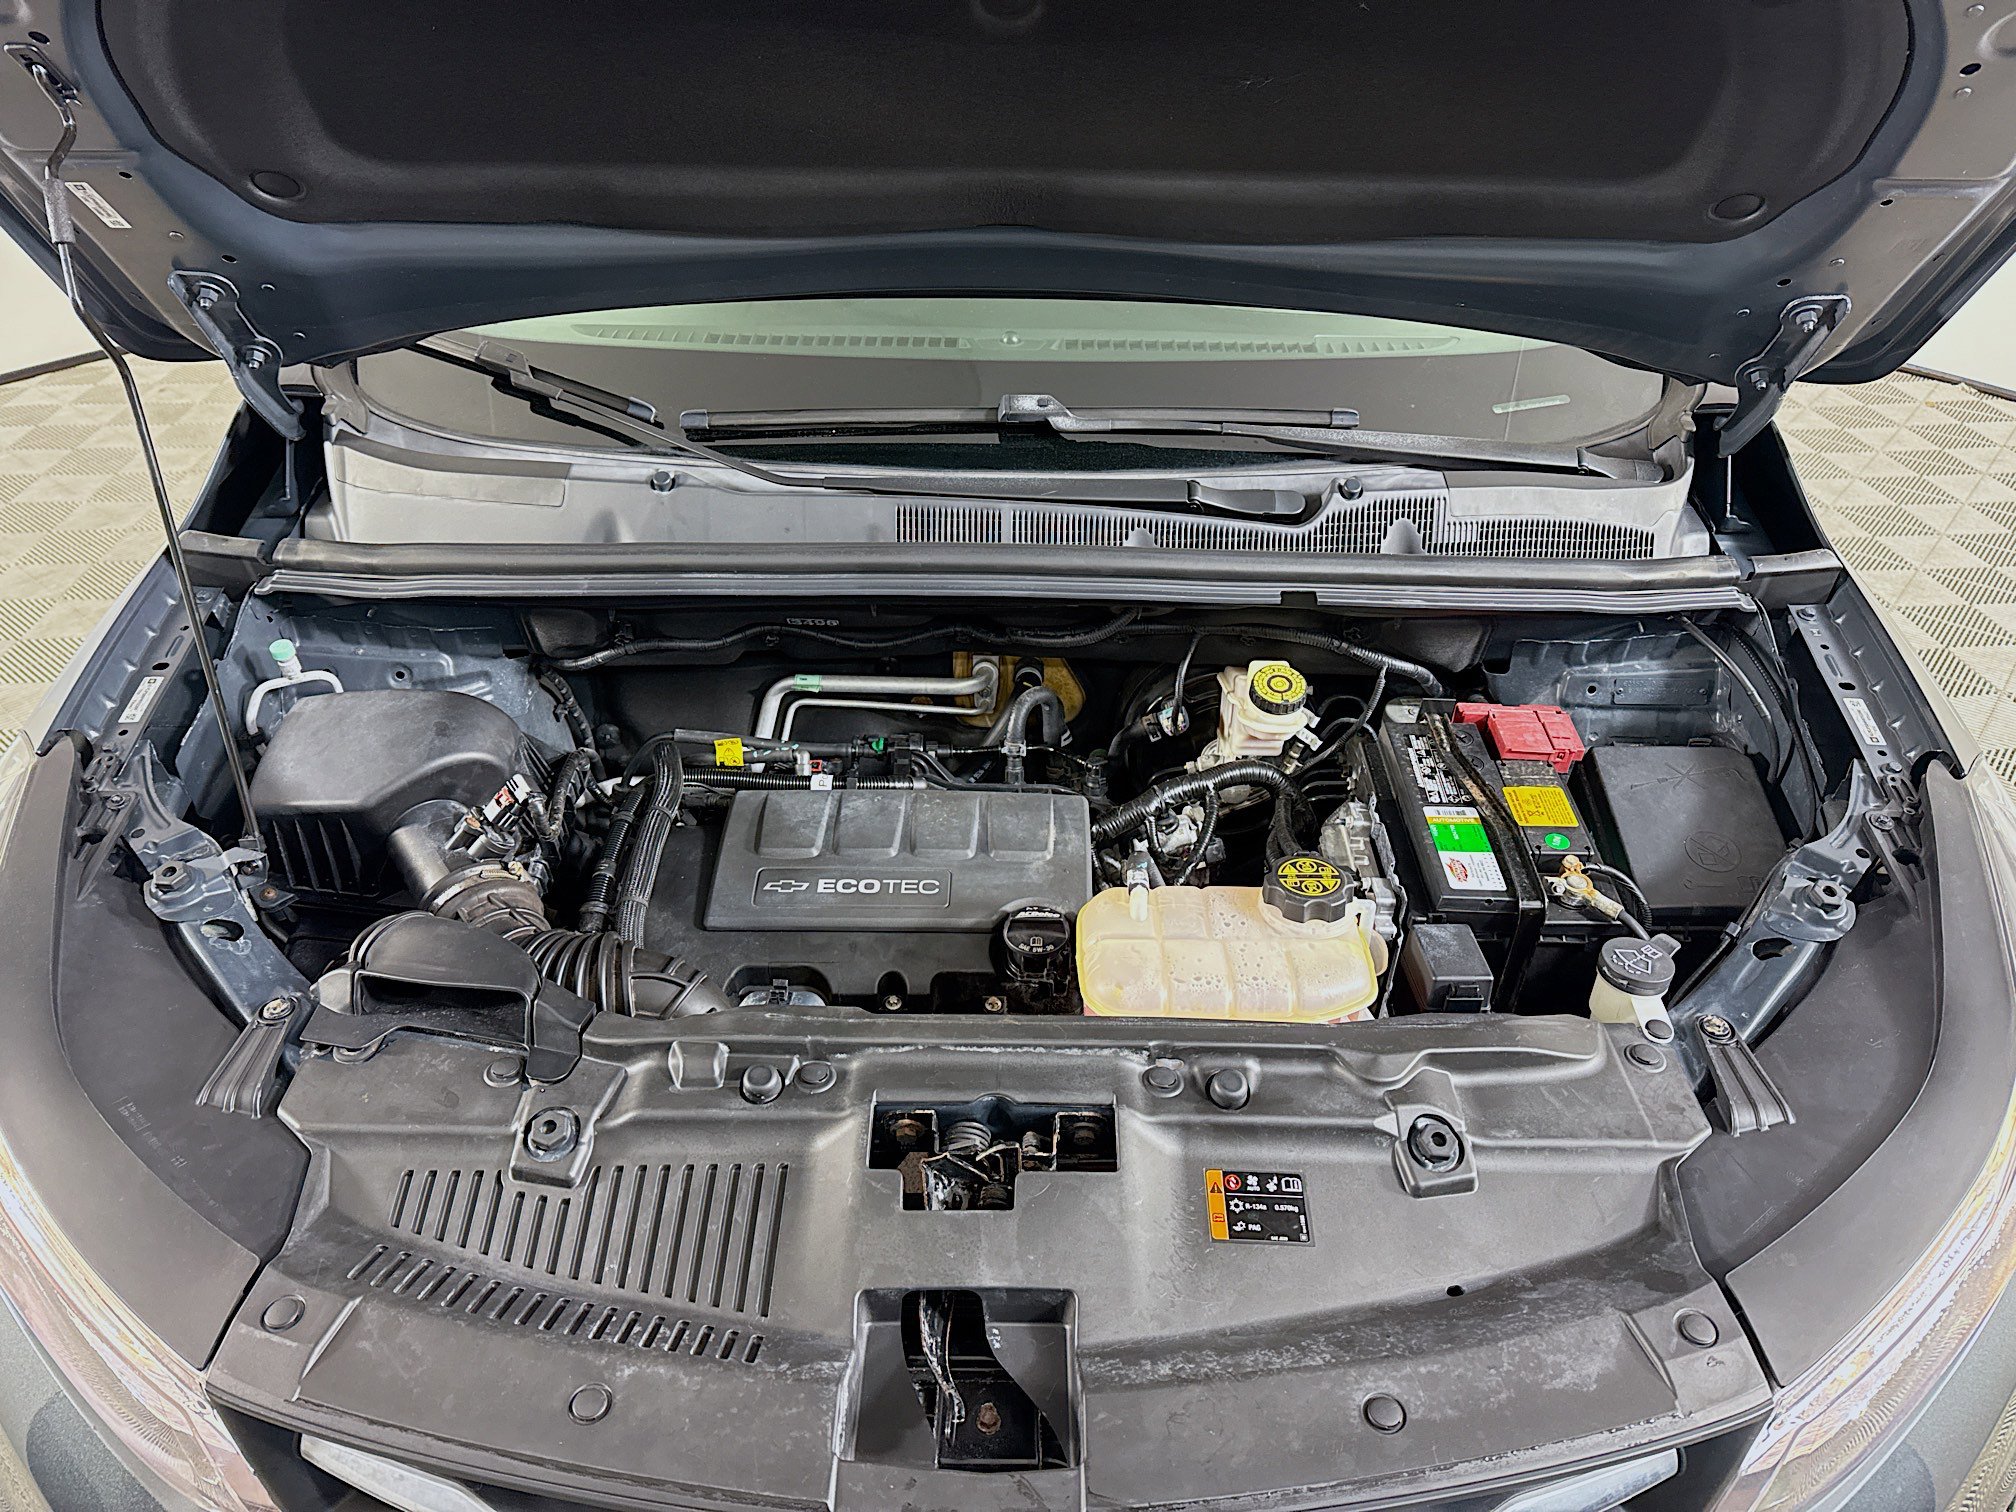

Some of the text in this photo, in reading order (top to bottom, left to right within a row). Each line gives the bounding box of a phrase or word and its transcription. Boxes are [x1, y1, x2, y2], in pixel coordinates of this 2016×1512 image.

[816, 878, 940, 895] ECOTEC
[1014, 911, 1061, 919] ACDelco
[1245, 1202, 1268, 1211] R-134a
[1247, 1223, 1262, 1232] PAG
